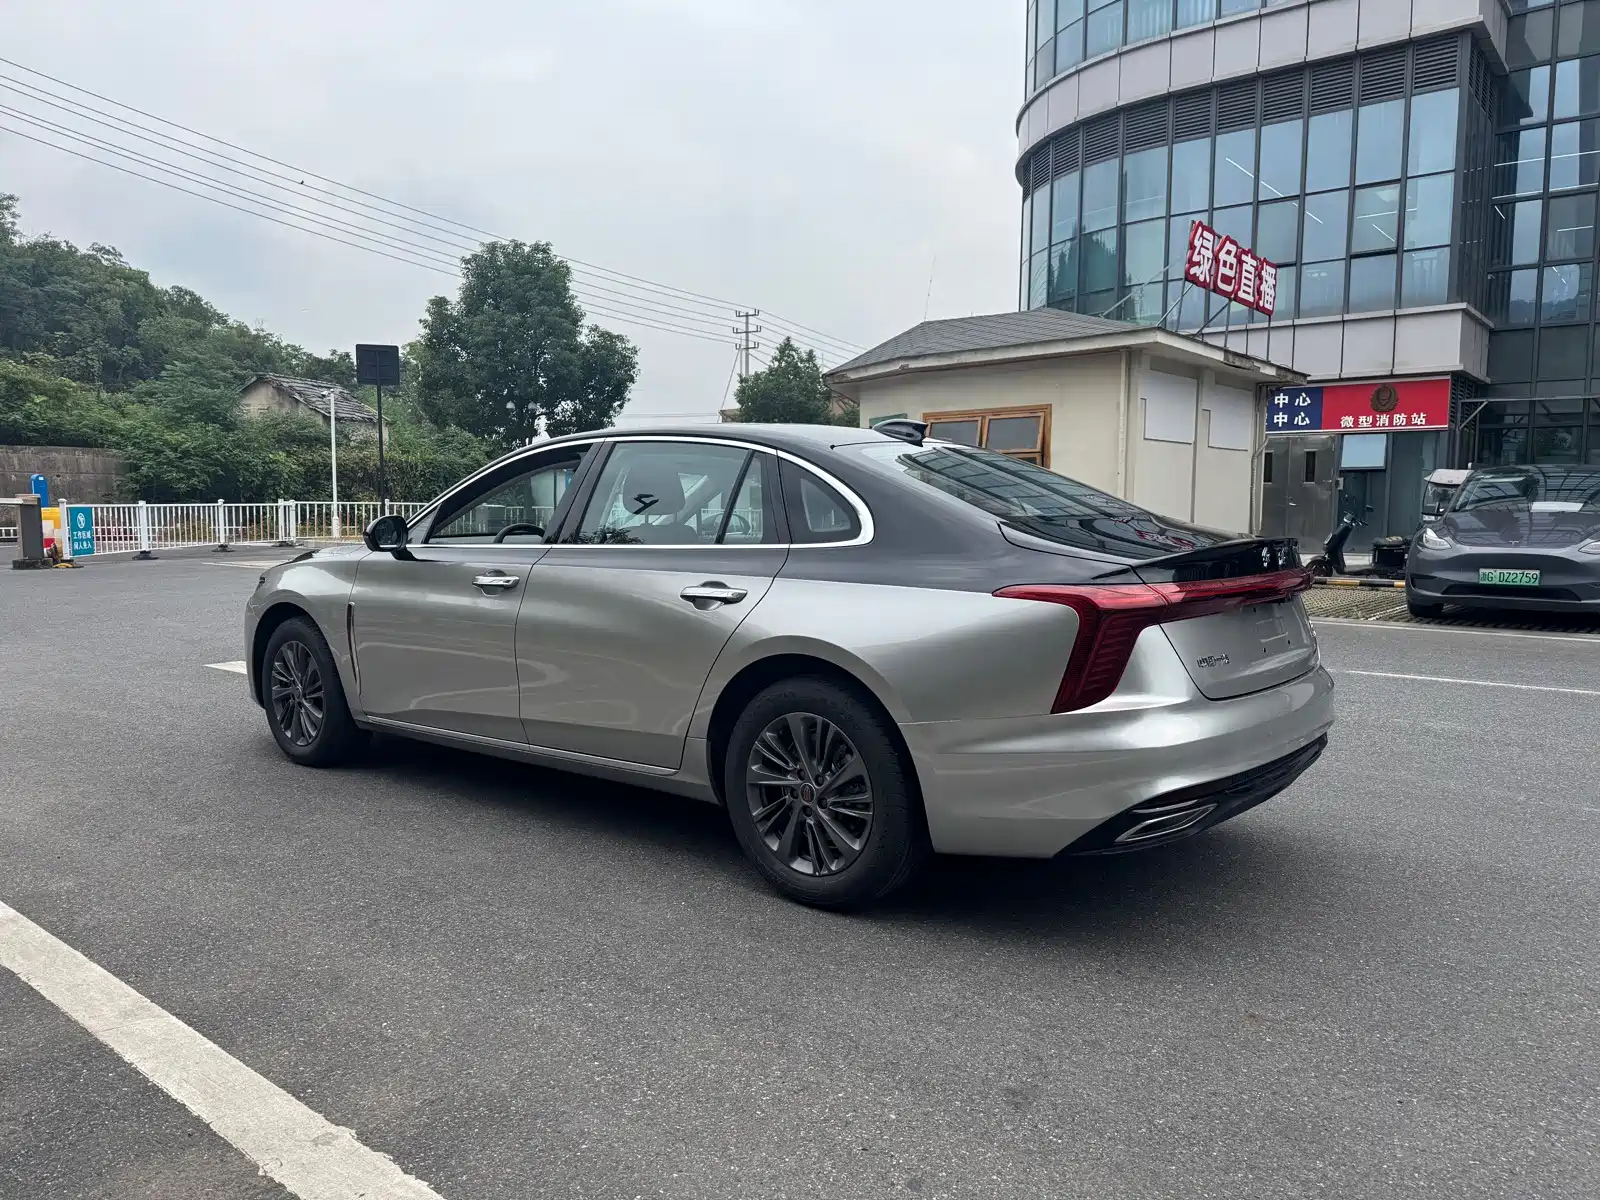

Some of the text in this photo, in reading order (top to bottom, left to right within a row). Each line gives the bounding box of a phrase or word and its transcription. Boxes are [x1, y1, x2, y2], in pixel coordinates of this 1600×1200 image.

[1189, 226, 1276, 311] 绿色直播
[1340, 412, 1427, 428] 微型消防站
[1498, 571, 1538, 583] DZ2759
